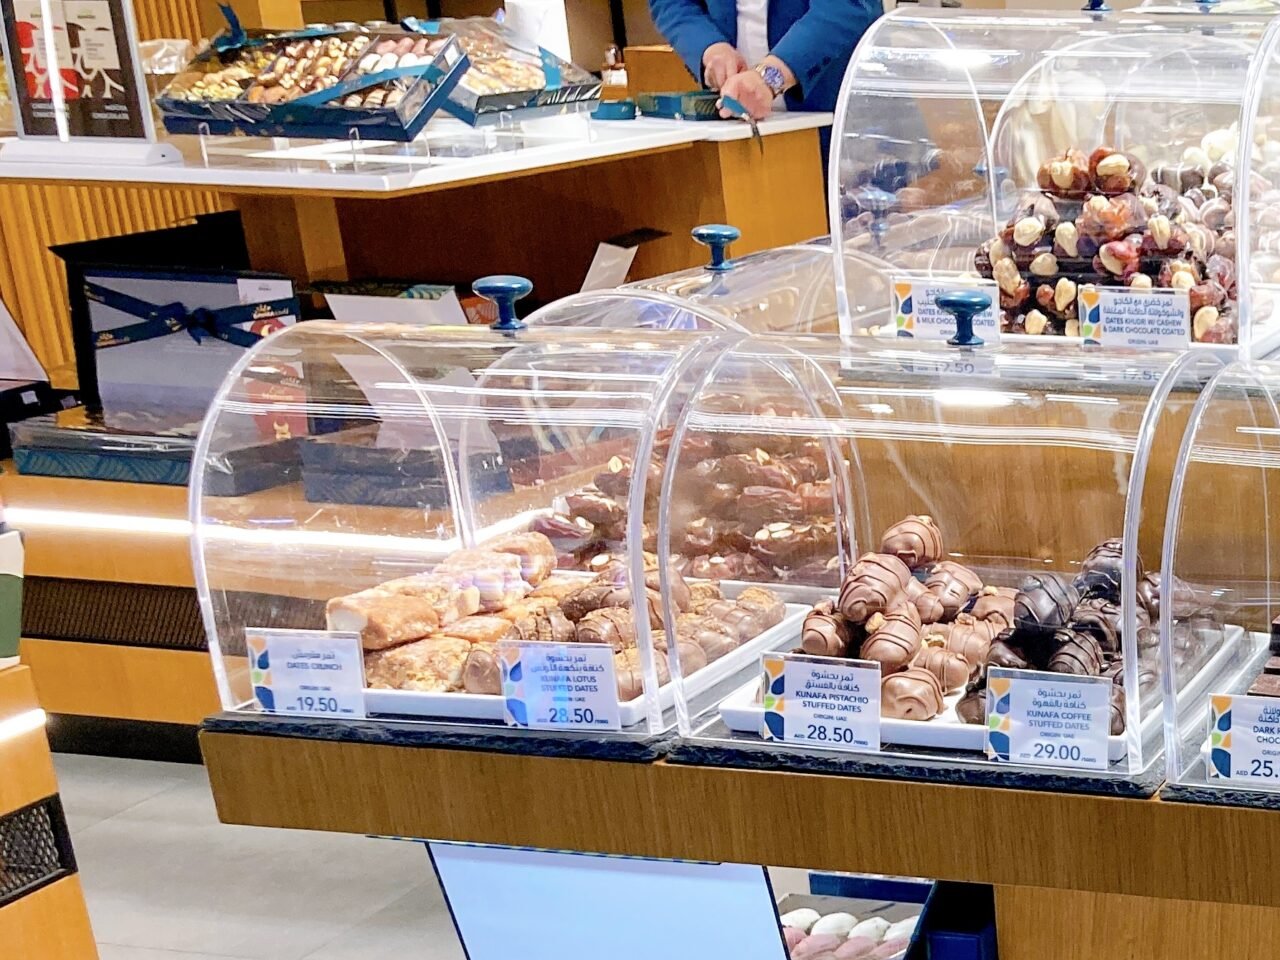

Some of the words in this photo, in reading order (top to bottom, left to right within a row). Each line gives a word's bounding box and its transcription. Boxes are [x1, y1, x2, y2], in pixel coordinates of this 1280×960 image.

[1105, 316, 1124, 324] DATES
[1124, 318, 1146, 326] KHUDRI
[1156, 319, 1182, 327] CASHEW
[1108, 326, 1124, 334] DARK
[1125, 327, 1161, 335] CHOCOLATE
[1161, 328, 1185, 336] COATED
[286, 661, 310, 669] DATES
[811, 669, 839, 680] بحشوة
[841, 672, 854, 682] تمر
[795, 690, 828, 700] KUNAFA
[829, 693, 869, 704] PISTACHIO
[1037, 688, 1067, 698] بحشوة
[1068, 690, 1081, 700] تمر
[296, 696, 338, 713] 19.50
[802, 700, 836, 710] STUFFED
[837, 703, 862, 713] DATES
[548, 707, 594, 724] 28.50
[1026, 710, 1060, 719] KUNAFA
[1061, 711, 1092, 721] COFFEE
[1028, 719, 1063, 729] STUFFED
[1064, 721, 1090, 730] DATES
[1252, 725, 1275, 735] DARK
[807, 724, 854, 744] 28.50
[1033, 743, 1081, 761] 29.00
